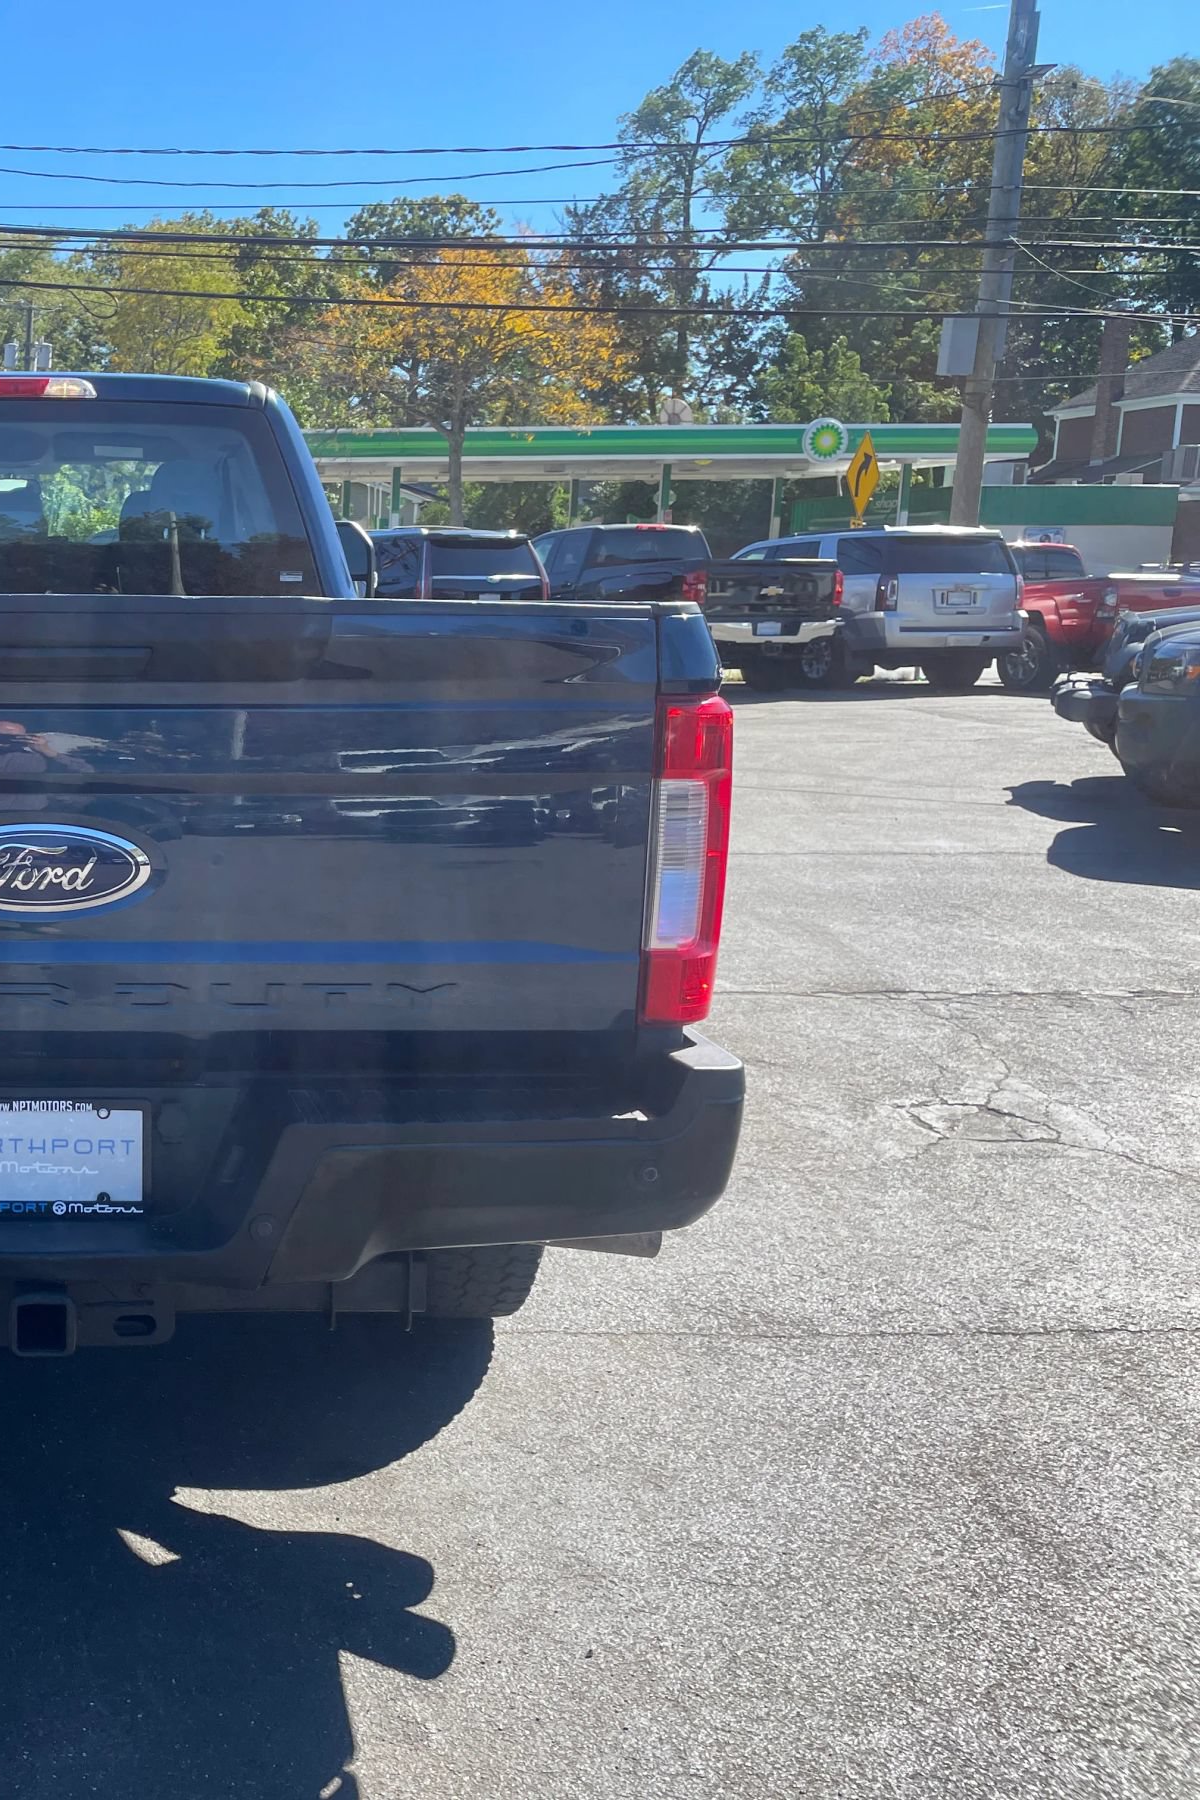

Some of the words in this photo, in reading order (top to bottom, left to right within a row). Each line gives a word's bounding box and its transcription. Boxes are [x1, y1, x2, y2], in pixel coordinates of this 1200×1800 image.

[114, 982, 458, 1010] DUTY
[0, 1160, 99, 1175] Motors
[68, 1203, 144, 1214] Motors
